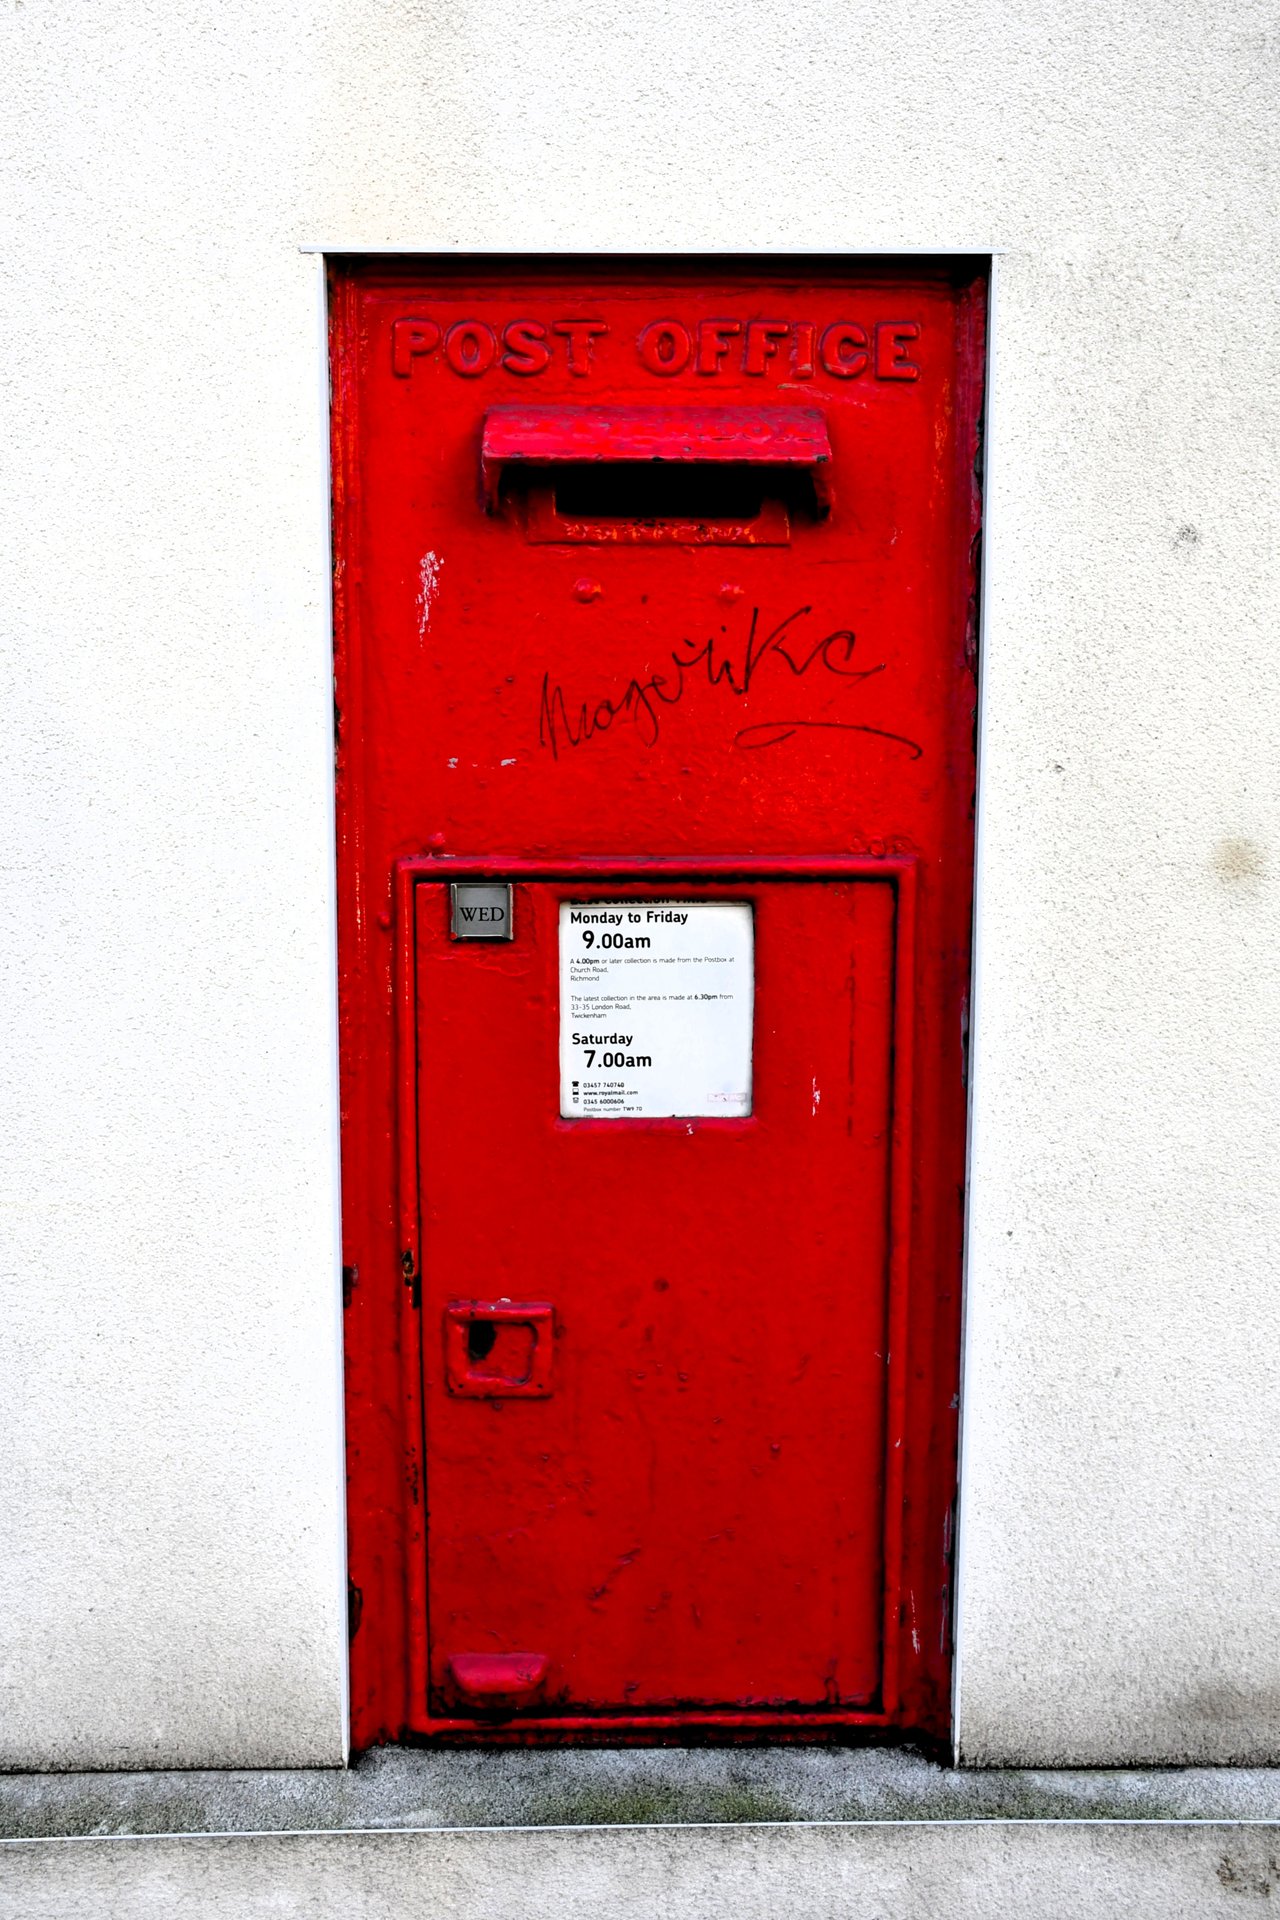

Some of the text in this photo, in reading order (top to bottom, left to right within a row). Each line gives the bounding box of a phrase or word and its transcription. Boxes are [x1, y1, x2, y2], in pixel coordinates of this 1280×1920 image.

[391, 318, 921, 382] POST OFFICE
[459, 907, 505, 922] WED
[570, 911, 688, 925] Monday to Friday
[582, 930, 651, 949] 9.00am
[572, 1033, 633, 1046] Saturday
[584, 1050, 652, 1068] 7.00am
